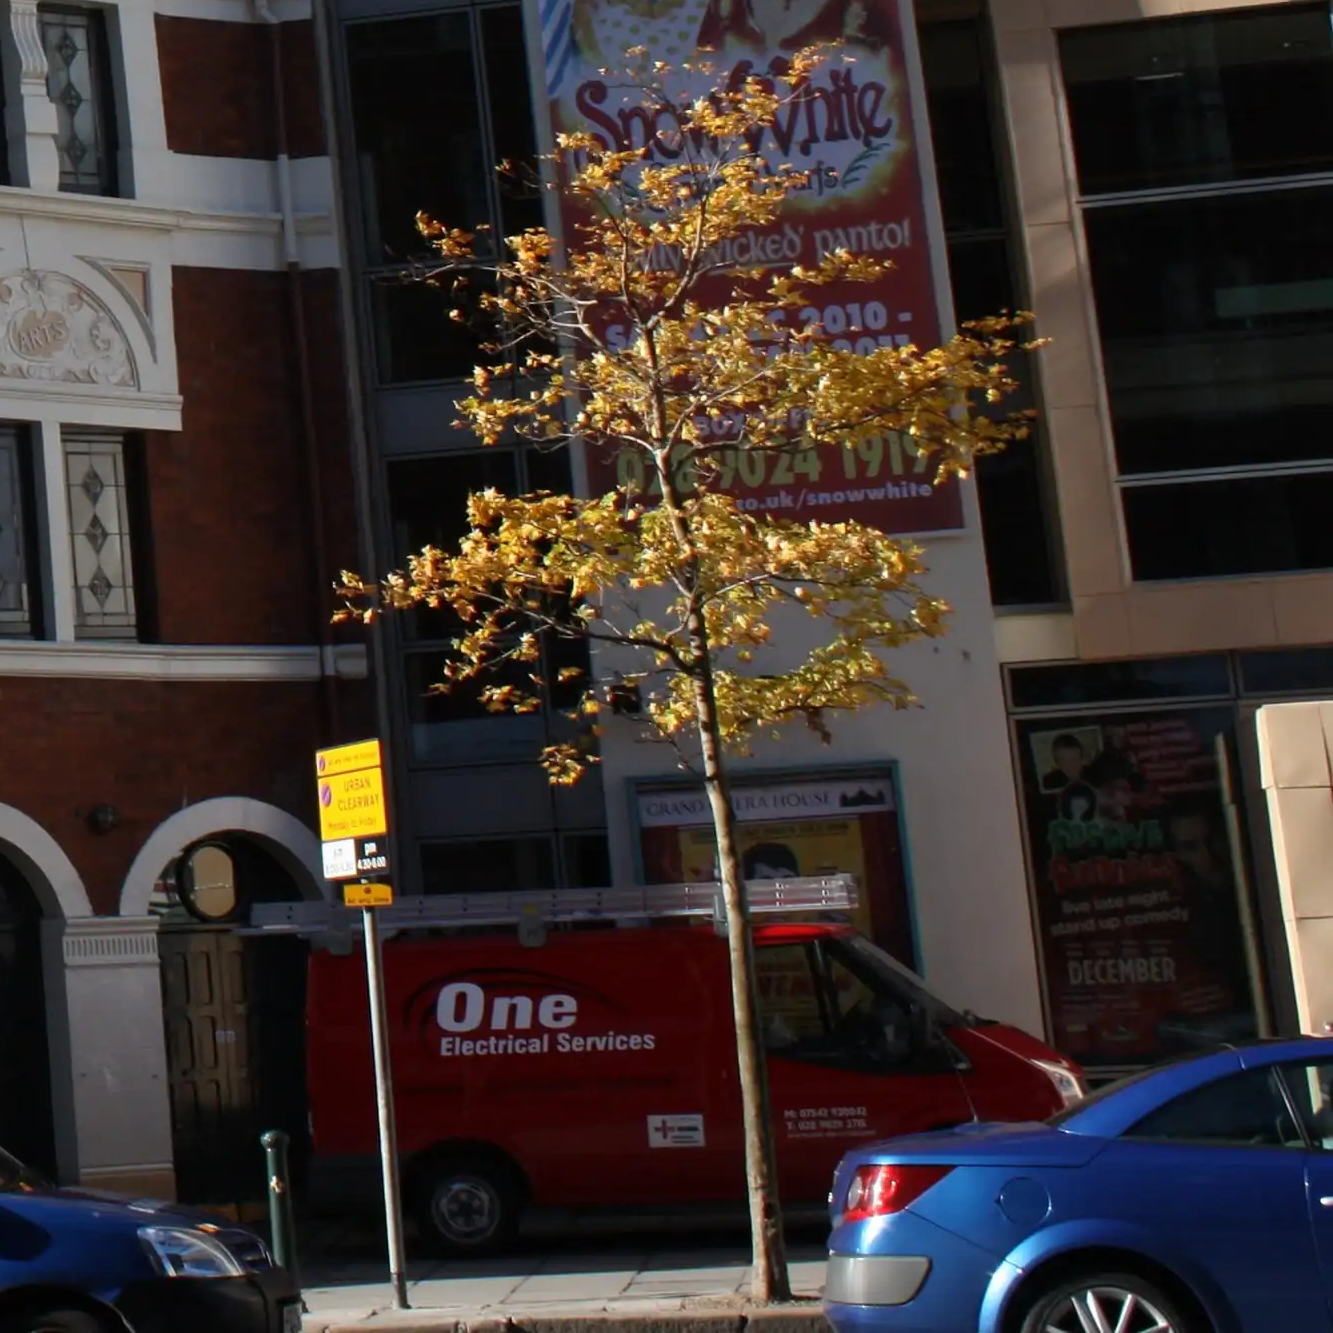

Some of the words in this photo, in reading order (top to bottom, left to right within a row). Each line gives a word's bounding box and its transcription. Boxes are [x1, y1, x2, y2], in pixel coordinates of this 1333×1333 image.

[814, 218, 910, 261] panto!
[798, 301, 888, 335] 2010
[18, 320, 64, 352] ARTS
[343, 776, 371, 793] URBAN
[337, 793, 380, 812] CLEARWAY
[645, 799, 704, 816] GRAND
[773, 789, 830, 807] HOUSE
[1067, 957, 1177, 986] DECEMBER
[435, 981, 579, 1033] One
[440, 1033, 549, 1057] Electrical
[556, 1031, 657, 1052] Services
